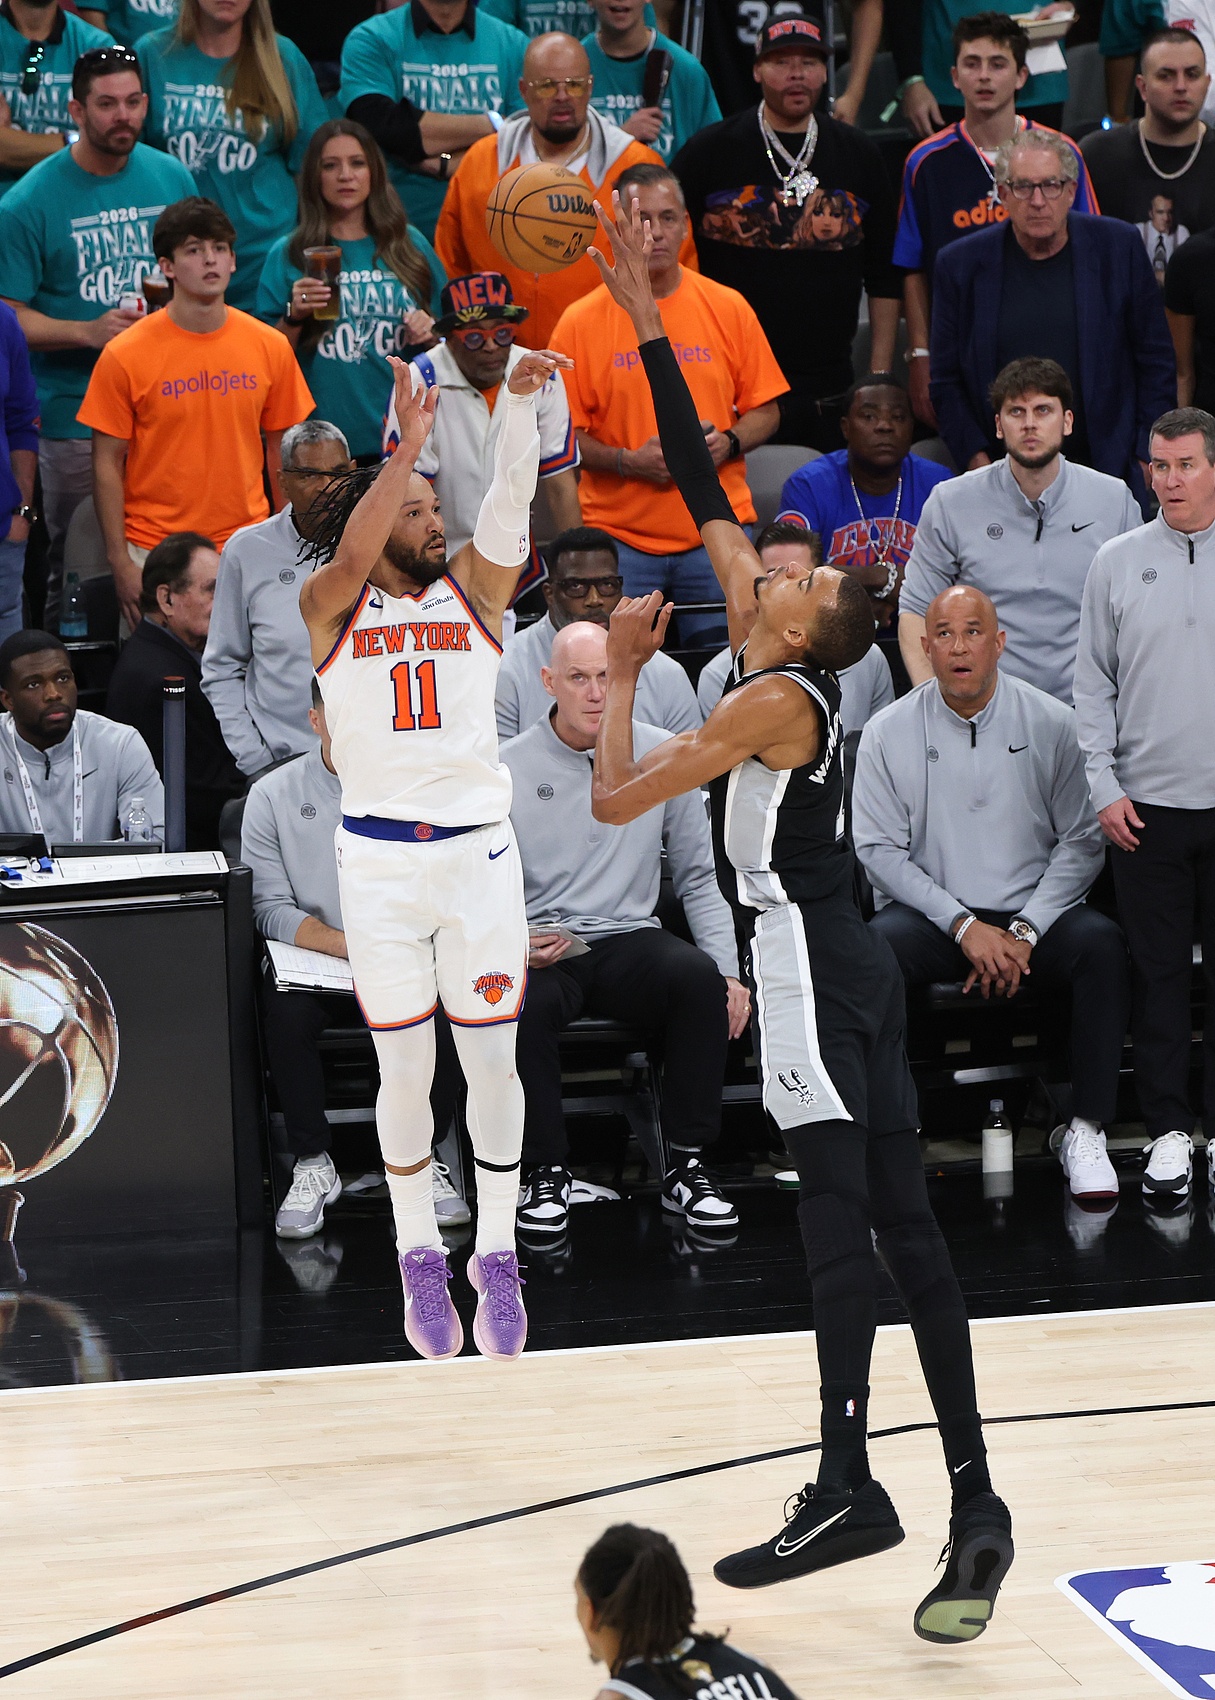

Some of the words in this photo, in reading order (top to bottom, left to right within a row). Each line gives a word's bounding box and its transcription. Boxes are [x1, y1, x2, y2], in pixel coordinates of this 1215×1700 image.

[218, 135, 257, 175] GO
[99, 206, 138, 226] 2026
[70, 220, 156, 278] FINAL
[80, 264, 116, 306] GO
[340, 269, 383, 284] 2026
[449, 277, 507, 313] NEW
[318, 323, 355, 364] GO
[613, 343, 713, 371] apjets
[161, 369, 258, 400] apollojets
[352, 622, 408, 660] NEW
[407, 620, 472, 652] YORK
[389, 658, 442, 732] 11
[473, 973, 514, 993] KNICKS
